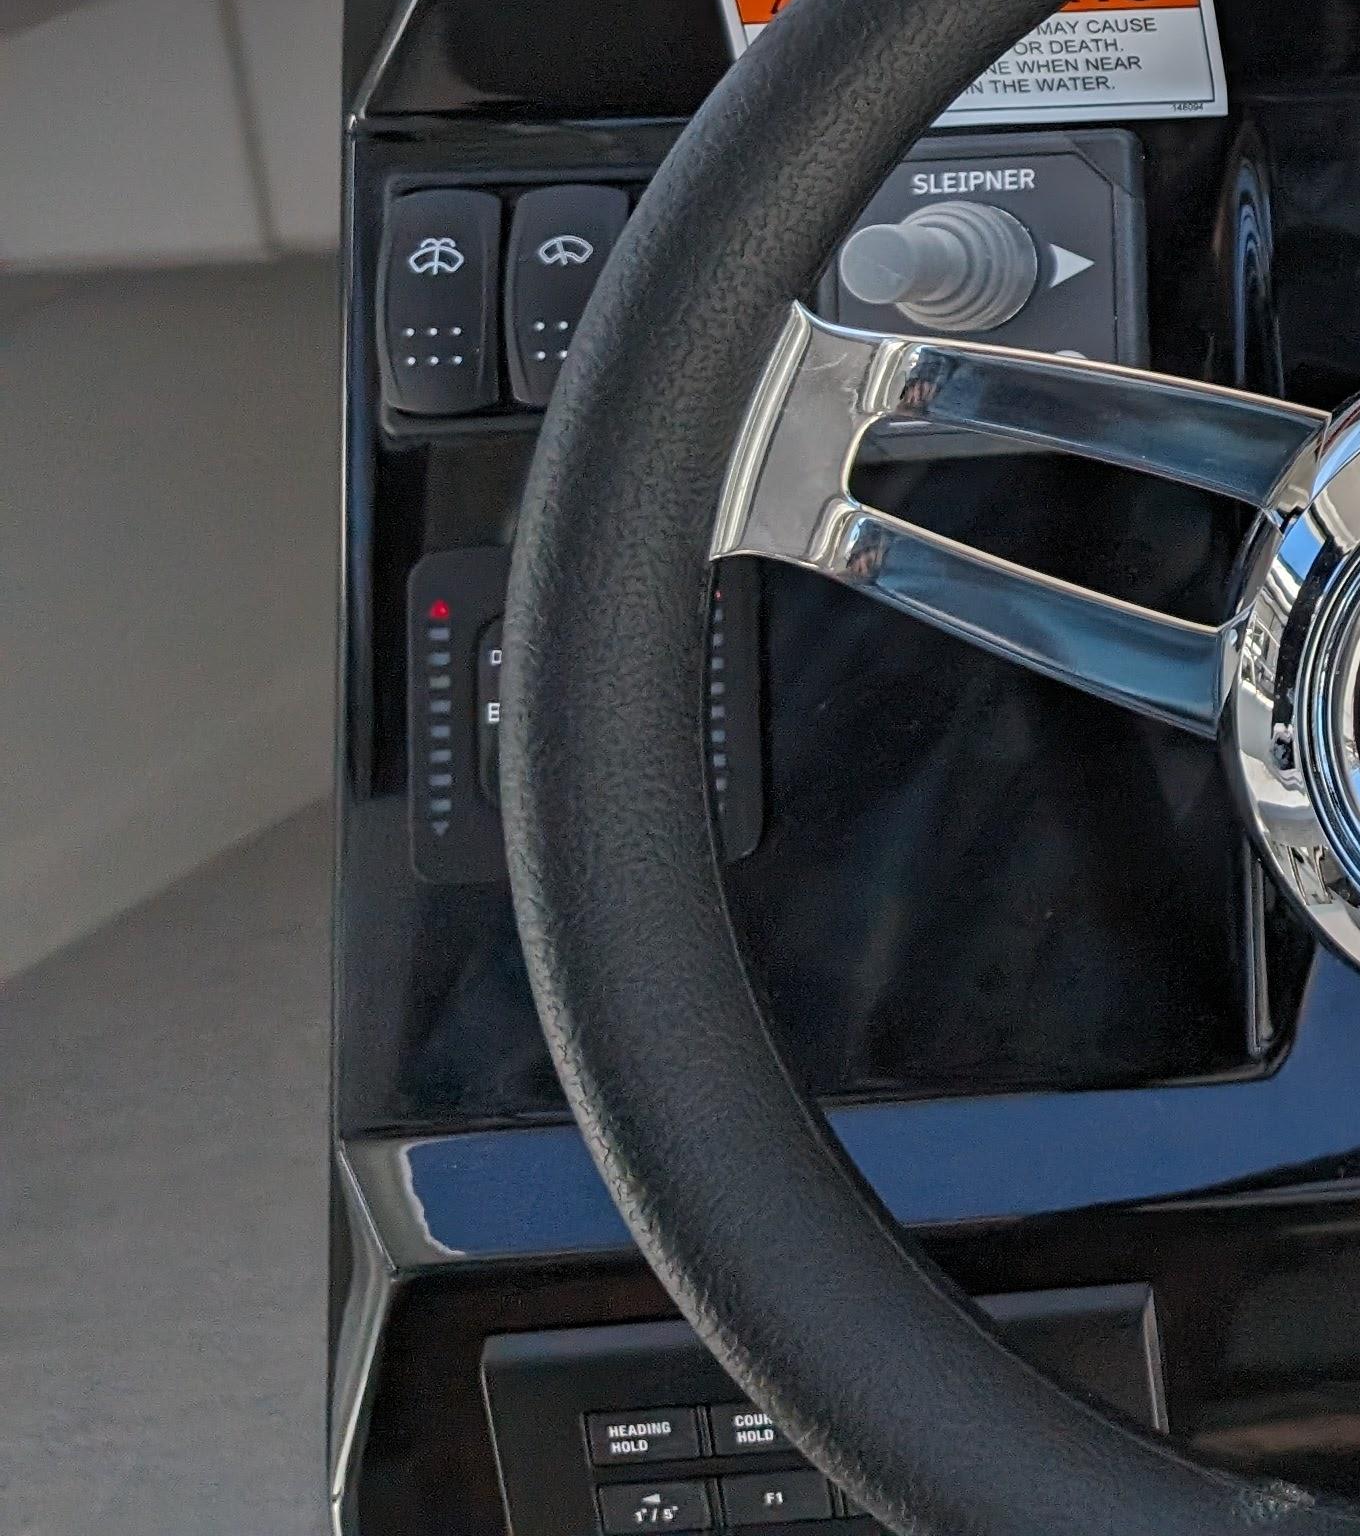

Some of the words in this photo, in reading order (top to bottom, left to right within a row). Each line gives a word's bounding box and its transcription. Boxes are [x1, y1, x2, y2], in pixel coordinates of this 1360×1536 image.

[1036, 19, 1080, 36] MAY
[1086, 17, 1158, 34] CAUSE
[1013, 40, 1044, 56] OR
[1049, 38, 1125, 55] DEATH.
[1015, 58, 1079, 75] WHEN
[1085, 55, 1143, 72] NEAR
[988, 79, 1031, 93] THE
[1036, 76, 1116, 93] WATER.
[911, 168, 1036, 196] SLEIPNER
[607, 1421, 672, 1438] HEADING
[736, 1428, 775, 1444] HOLD
[611, 1440, 649, 1454] HOLD
[764, 1491, 784, 1505] F1
